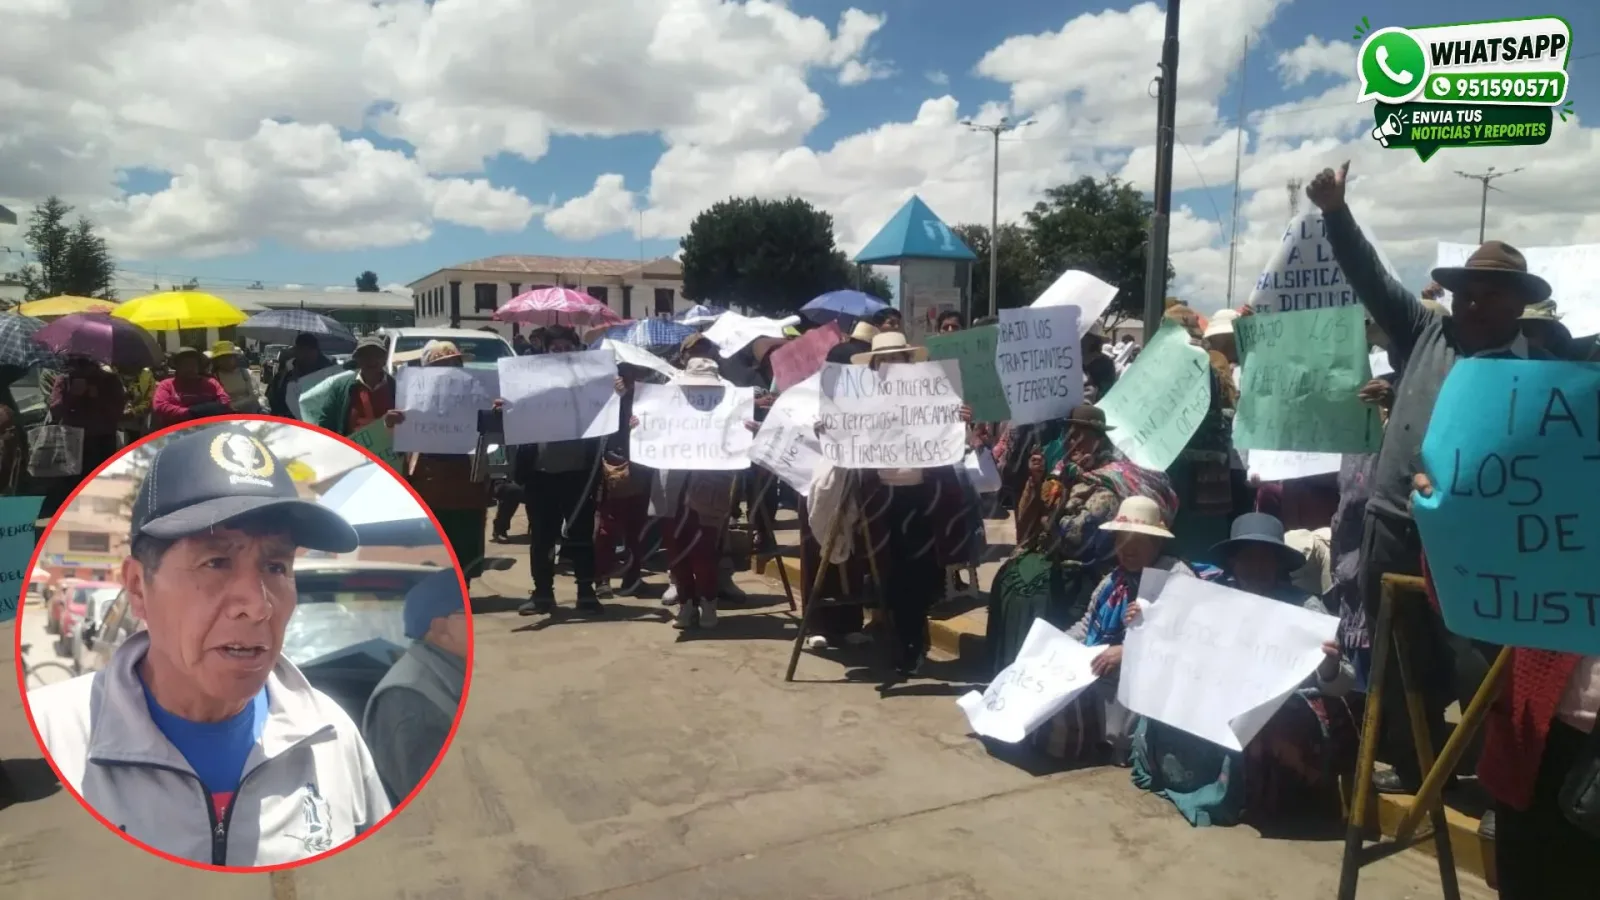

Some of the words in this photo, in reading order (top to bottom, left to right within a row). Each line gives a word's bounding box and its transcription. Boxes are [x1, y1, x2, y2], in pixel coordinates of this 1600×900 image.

[1283, 219, 1327, 241] ALT
[1287, 245, 1304, 265] A
[1316, 243, 1337, 262] L
[1256, 267, 1347, 290] FALSIFICA
[1000, 321, 1029, 343] BAJO
[1034, 319, 1053, 339] LOS
[1308, 312, 1348, 343] LOS
[998, 346, 1073, 374] TRAFICANTES
[1004, 384, 1013, 405] E
[1016, 375, 1069, 404] TERRENOS
[851, 434, 898, 463] FIRMAS
[905, 433, 952, 463] FALSAS
[1450, 448, 1543, 506] LOS
[1517, 513, 1586, 553] DE
